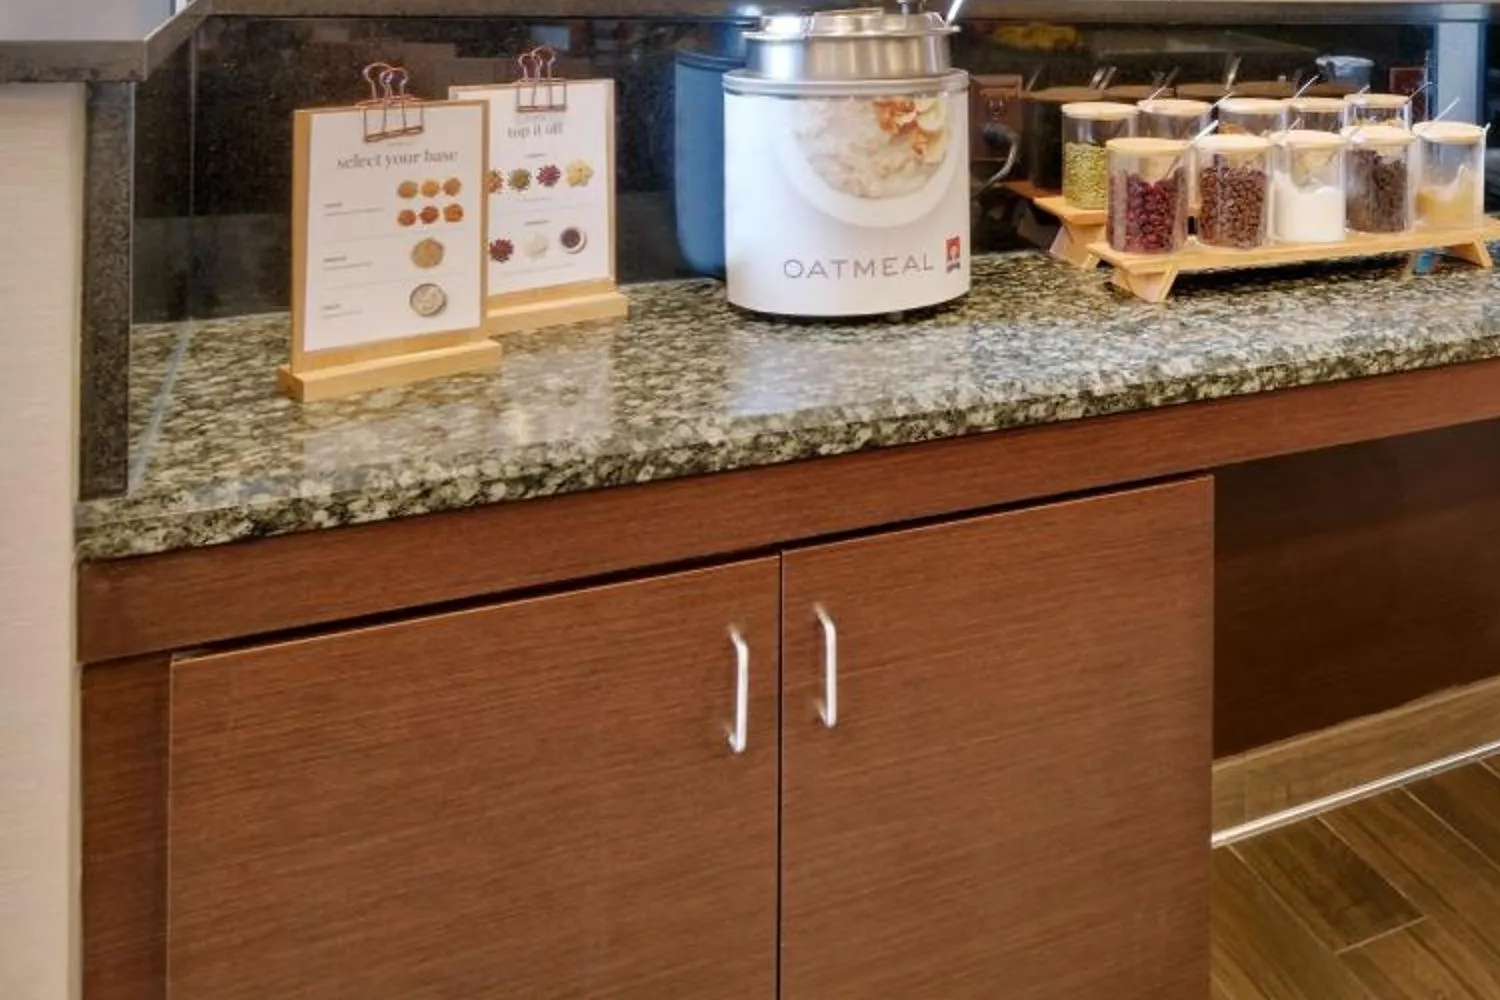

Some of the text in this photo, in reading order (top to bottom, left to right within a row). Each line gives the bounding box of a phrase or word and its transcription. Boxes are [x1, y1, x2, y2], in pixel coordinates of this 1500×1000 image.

[507, 126, 530, 139] top
[337, 149, 459, 170] select your base
[783, 252, 935, 280] OATMEAL
